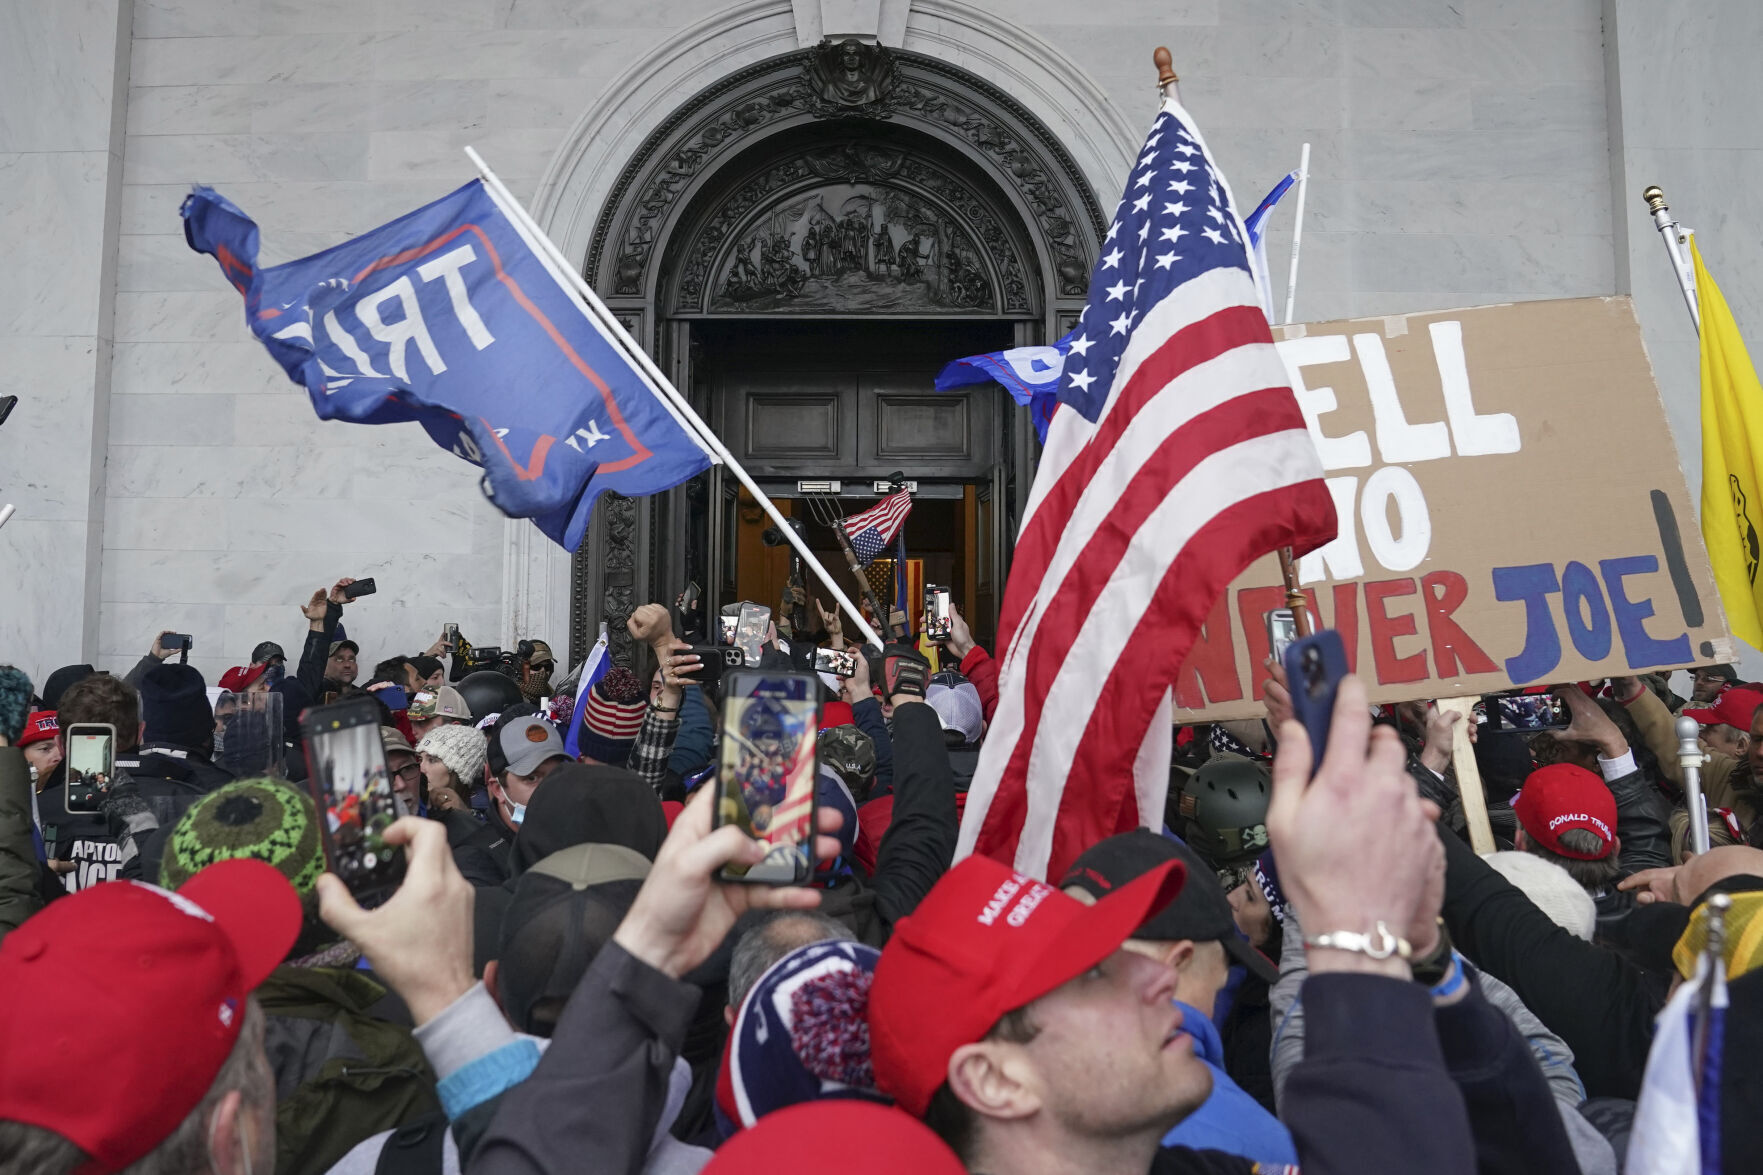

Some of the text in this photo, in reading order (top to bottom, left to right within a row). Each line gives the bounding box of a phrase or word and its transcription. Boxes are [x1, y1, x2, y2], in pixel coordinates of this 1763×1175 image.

[1275, 320, 1522, 470] ELL
[35, 717, 60, 732] TRU
[1549, 813, 1589, 830] DONALD
[71, 840, 122, 861] APITO
[977, 880, 1020, 926] MAKE
[1253, 859, 1285, 922] TRUM
